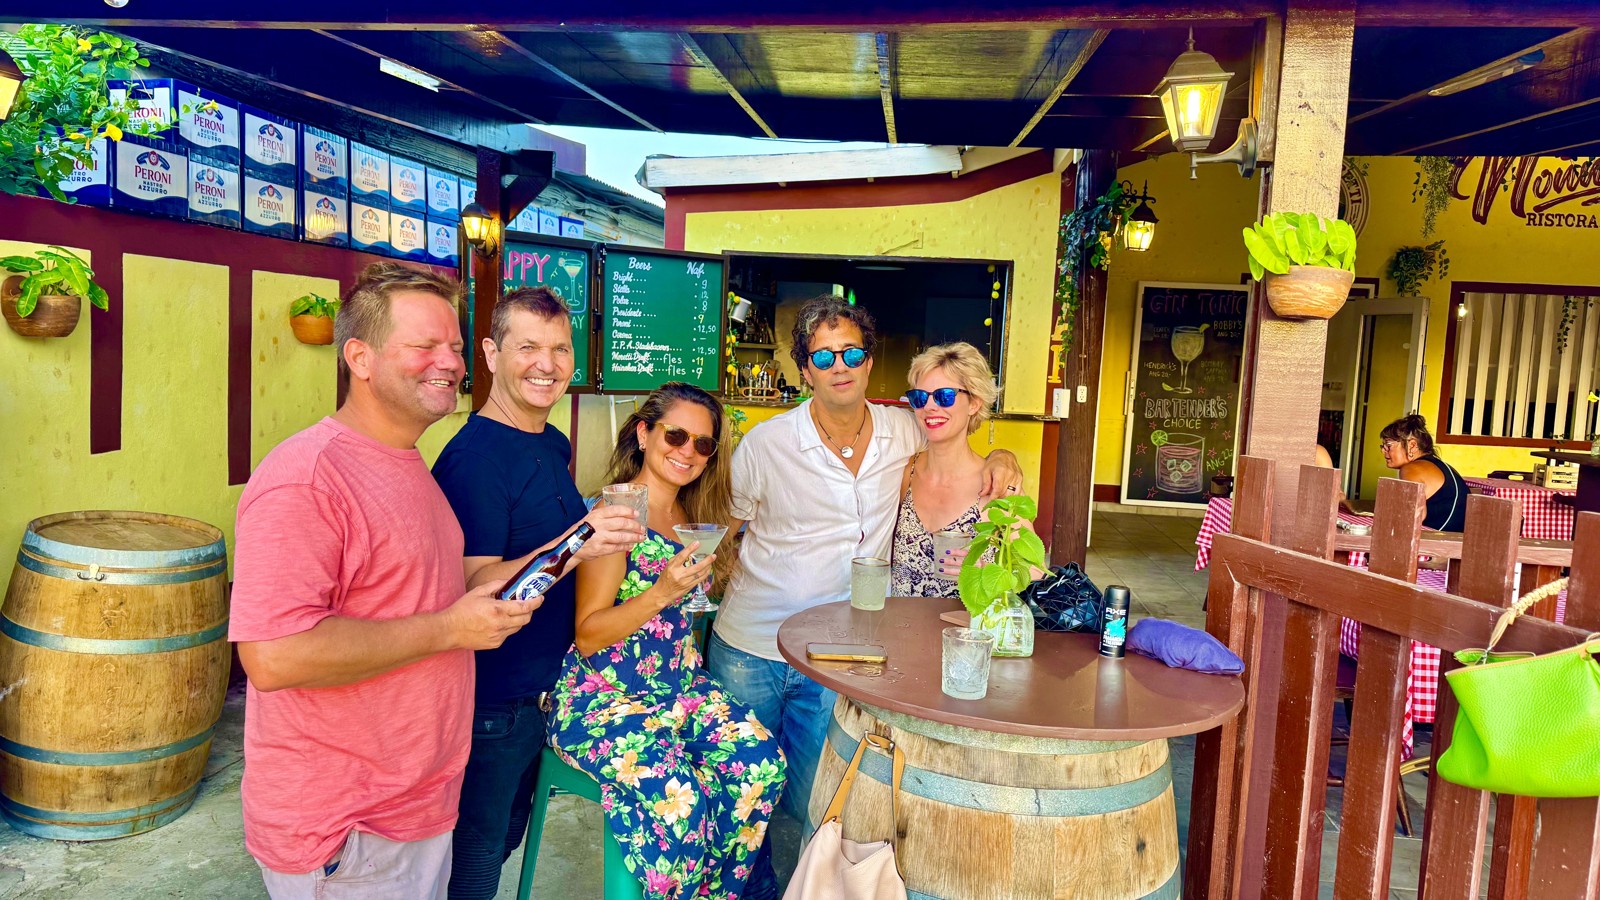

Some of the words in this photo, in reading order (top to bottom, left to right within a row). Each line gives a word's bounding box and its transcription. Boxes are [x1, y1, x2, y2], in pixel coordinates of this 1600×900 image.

[128, 106, 163, 118] RONI
[194, 113, 225, 134] PERONI
[197, 131, 222, 143] AZZURRO
[201, 128, 218, 137] NASTRO
[258, 135, 284, 153] PERONI
[315, 152, 336, 167] PERONI
[134, 164, 172, 185] PERONI
[360, 166, 380, 181] PERONI
[138, 184, 168, 195] AZZURRO
[142, 180, 163, 189] NASTRO
[194, 183, 226, 200] PERONI
[197, 200, 223, 209] AZZURRO
[257, 196, 284, 213] PERONI
[361, 220, 380, 232] PERONI
[628, 256, 652, 271] Beers
[612, 271, 634, 284] Bright
[701, 279, 708, 289] 9
[701, 291, 709, 300] 12
[702, 300, 708, 311] 8
[698, 314, 705, 324] 9
[697, 324, 716, 335] 12,50
[697, 346, 716, 356] 12,50
[663, 353, 683, 365] fles
[696, 357, 704, 367] 11
[668, 364, 687, 377] fles
[696, 367, 703, 380] 9
[1144, 395, 1228, 419] BARTENDER'S
[1163, 418, 1202, 430] CHOICE
[1206, 457, 1225, 472] ANG
[1105, 606, 1127, 616] AXE
